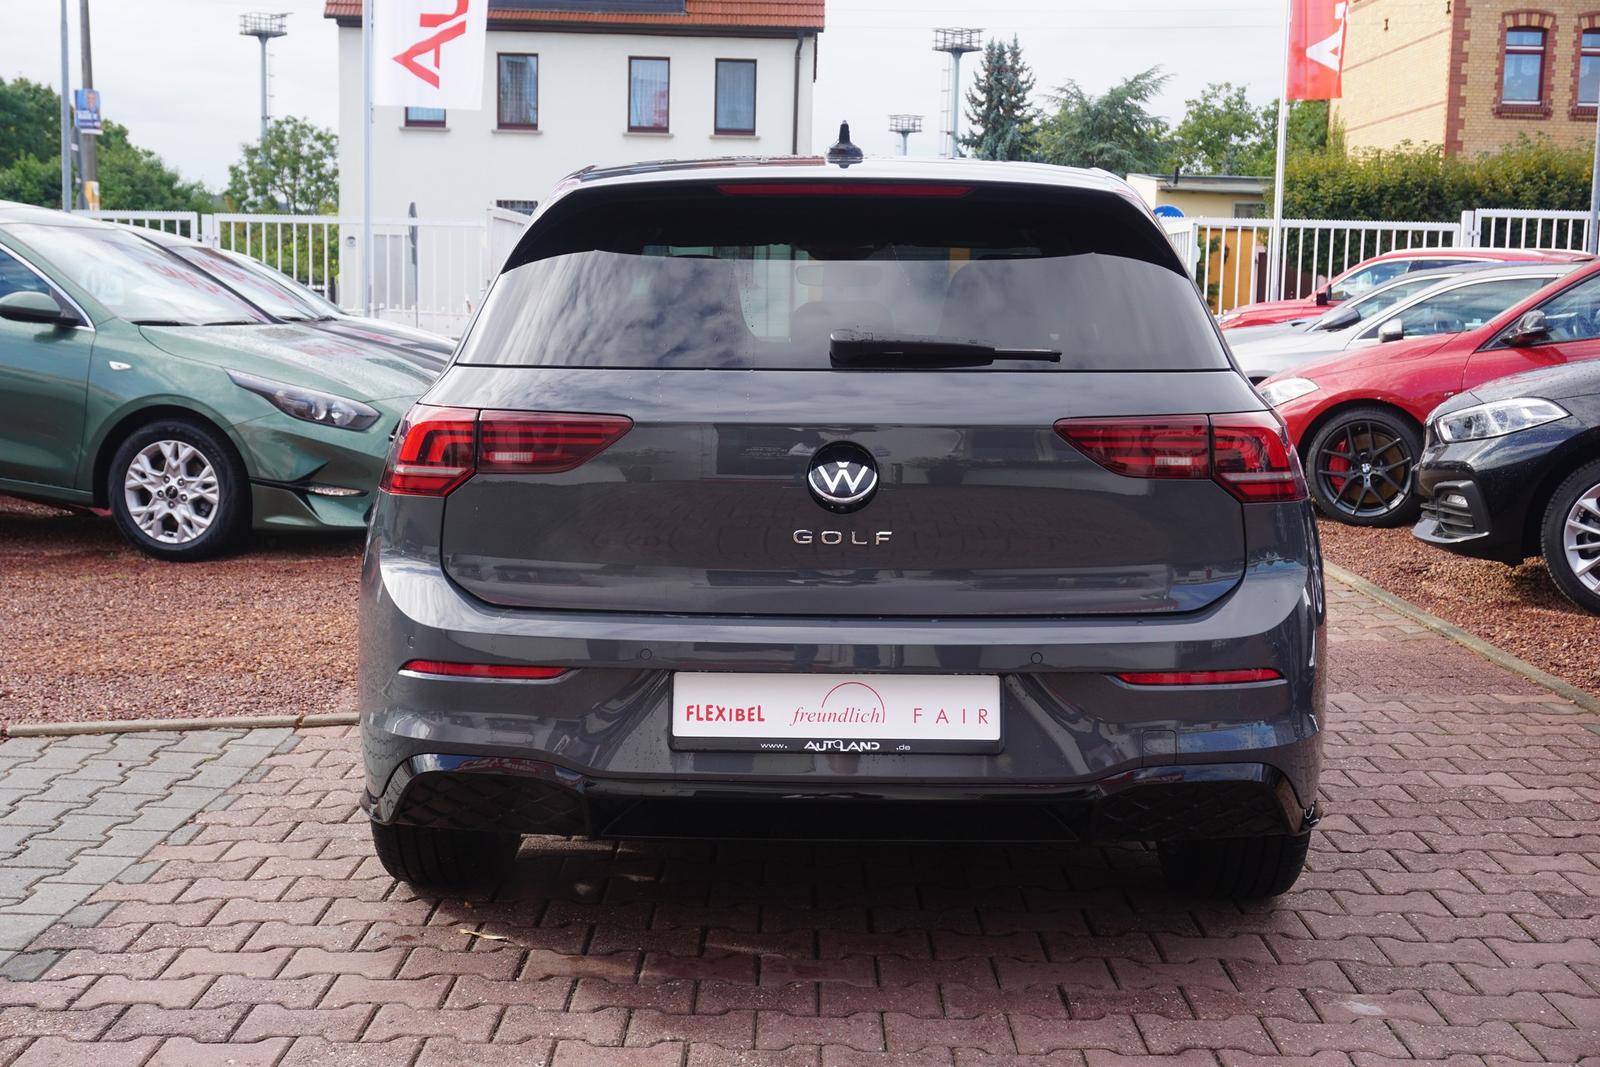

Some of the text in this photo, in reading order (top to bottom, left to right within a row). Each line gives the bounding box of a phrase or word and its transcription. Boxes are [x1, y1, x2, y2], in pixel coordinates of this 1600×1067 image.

[792, 529, 893, 546] GOLF
[685, 704, 766, 723] FLEXIBEL
[789, 706, 881, 727] freundlich
[803, 739, 881, 753] AUTOLAND
